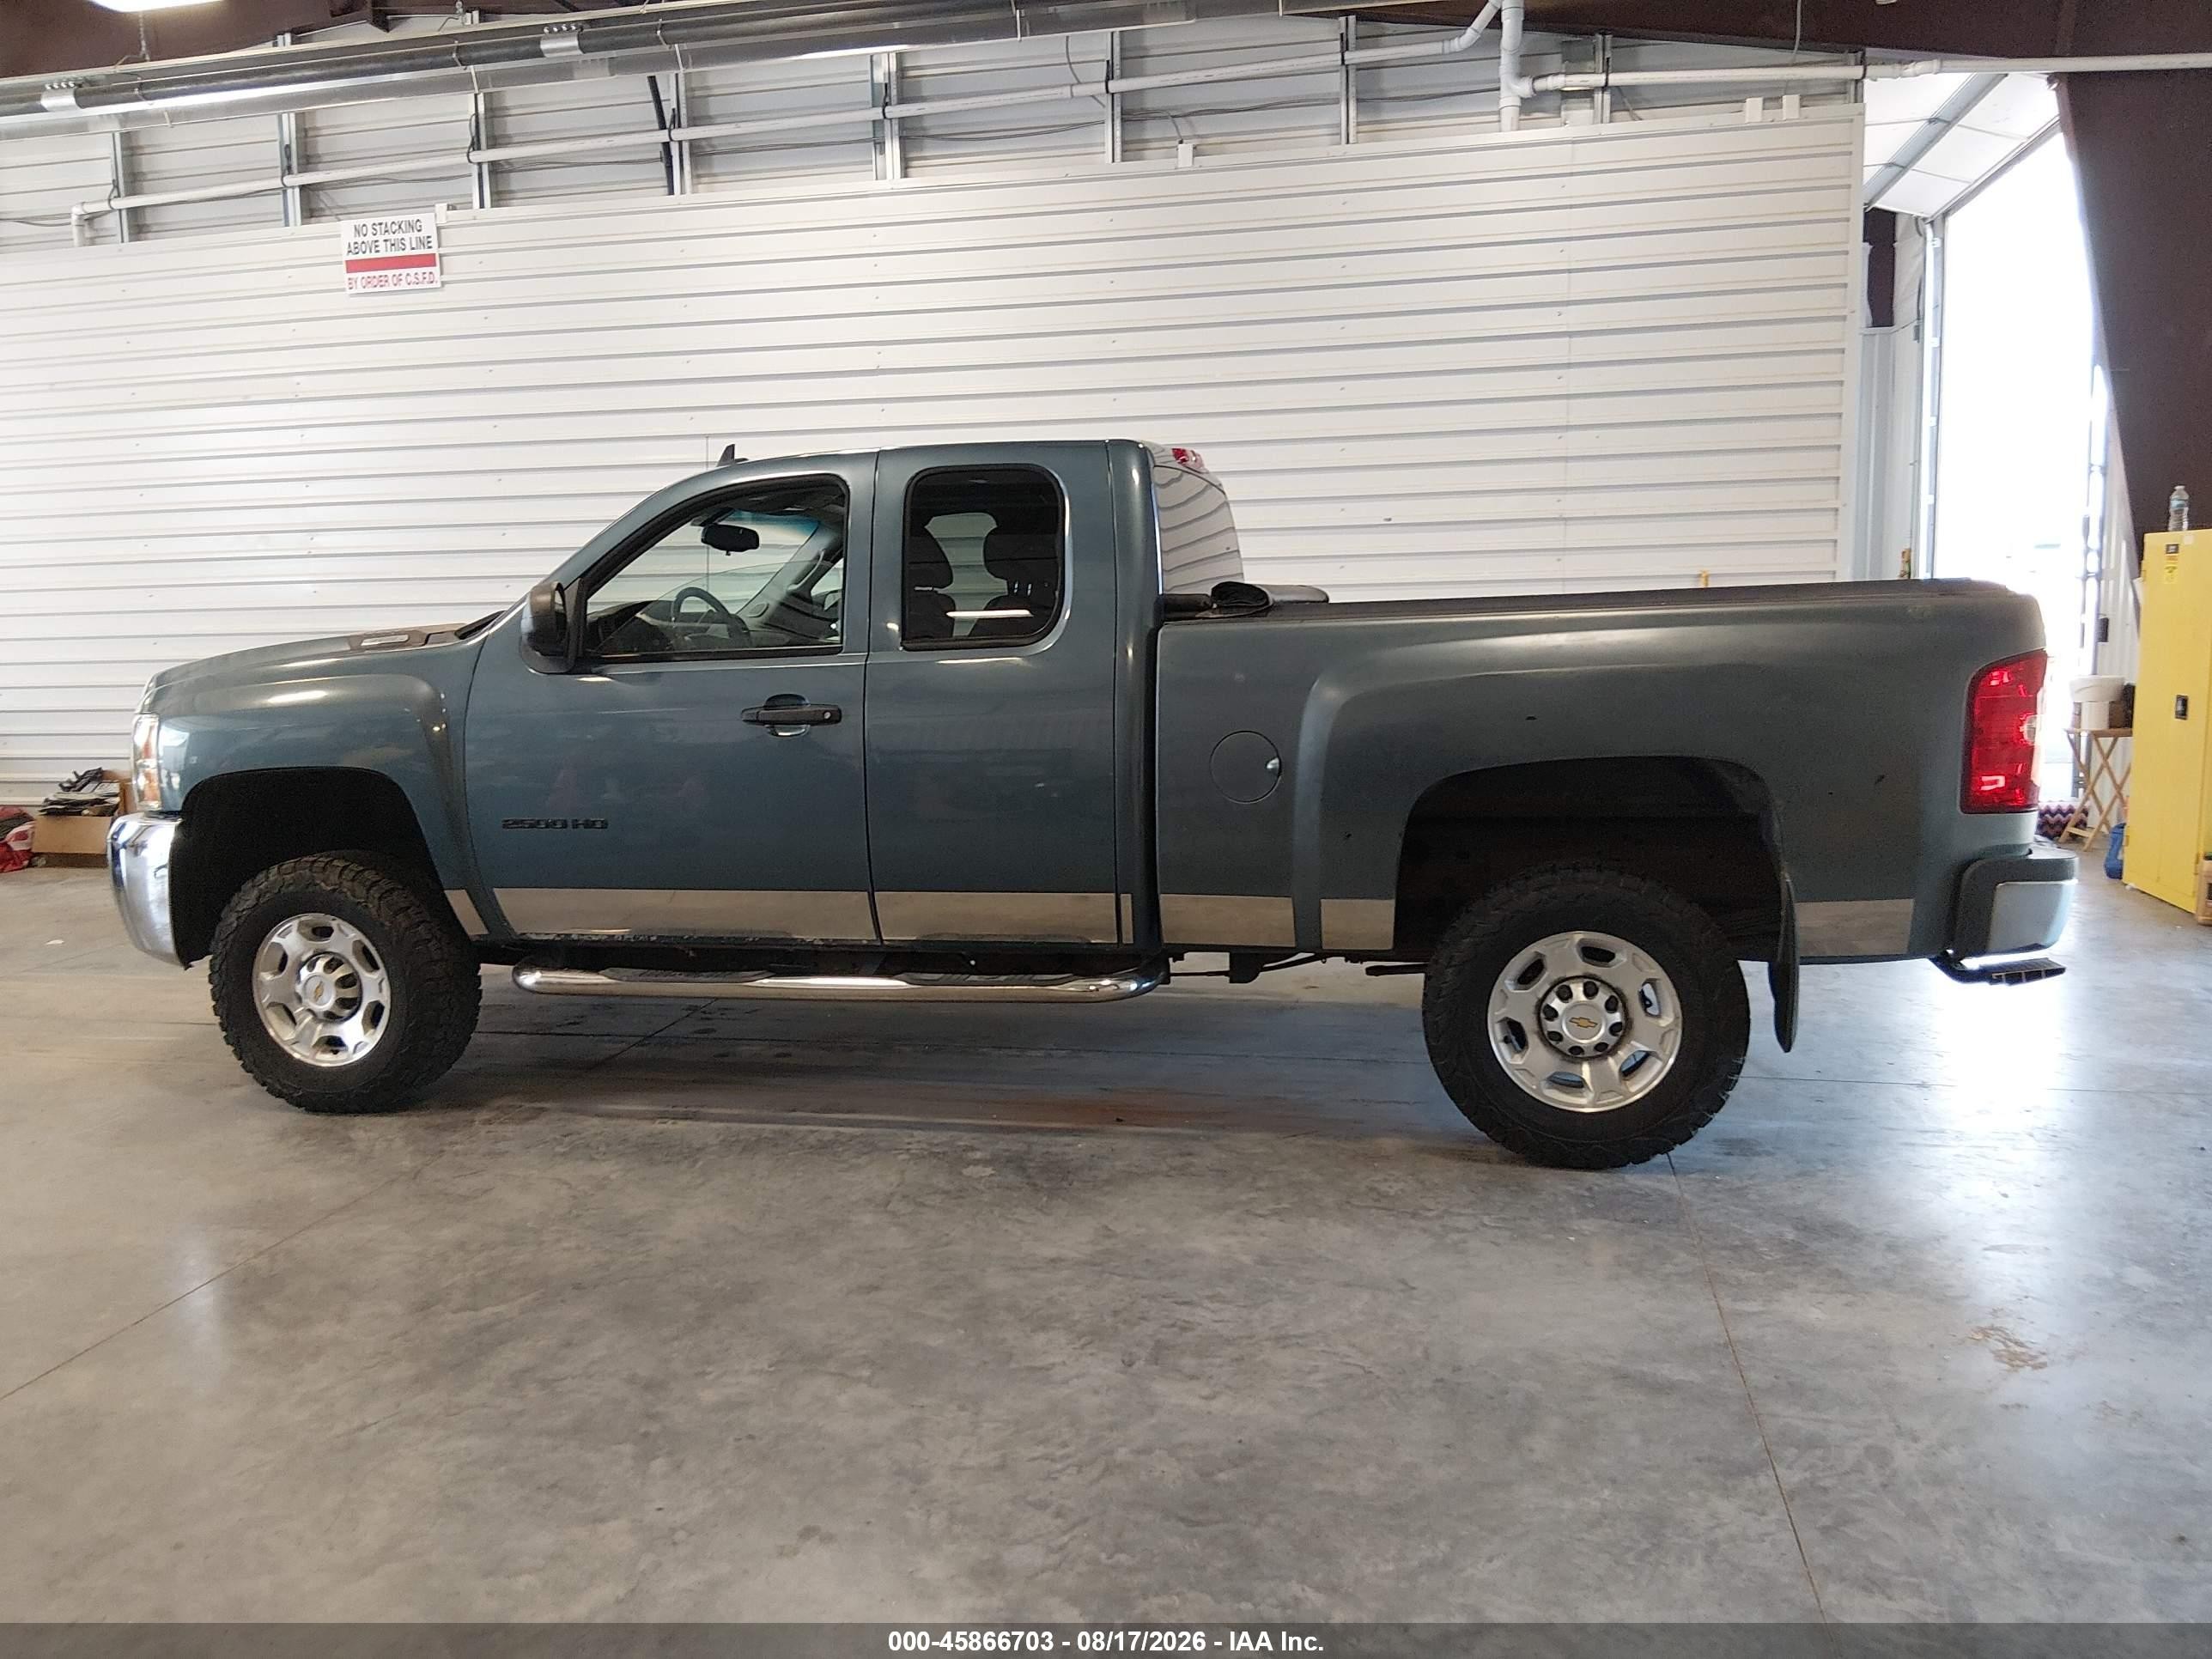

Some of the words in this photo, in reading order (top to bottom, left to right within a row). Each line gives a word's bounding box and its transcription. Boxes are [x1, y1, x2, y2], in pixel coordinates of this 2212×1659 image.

[354, 223, 368, 237] NO
[371, 219, 422, 236] STACKING
[347, 240, 380, 255] ABOVE
[383, 237, 406, 252] THIS
[410, 235, 433, 251] LINE
[348, 276, 358, 290] BY
[361, 275, 390, 289] ORDER
[392, 273, 403, 287] OF
[501, 818, 568, 830] 2500
[571, 818, 609, 830] HD
